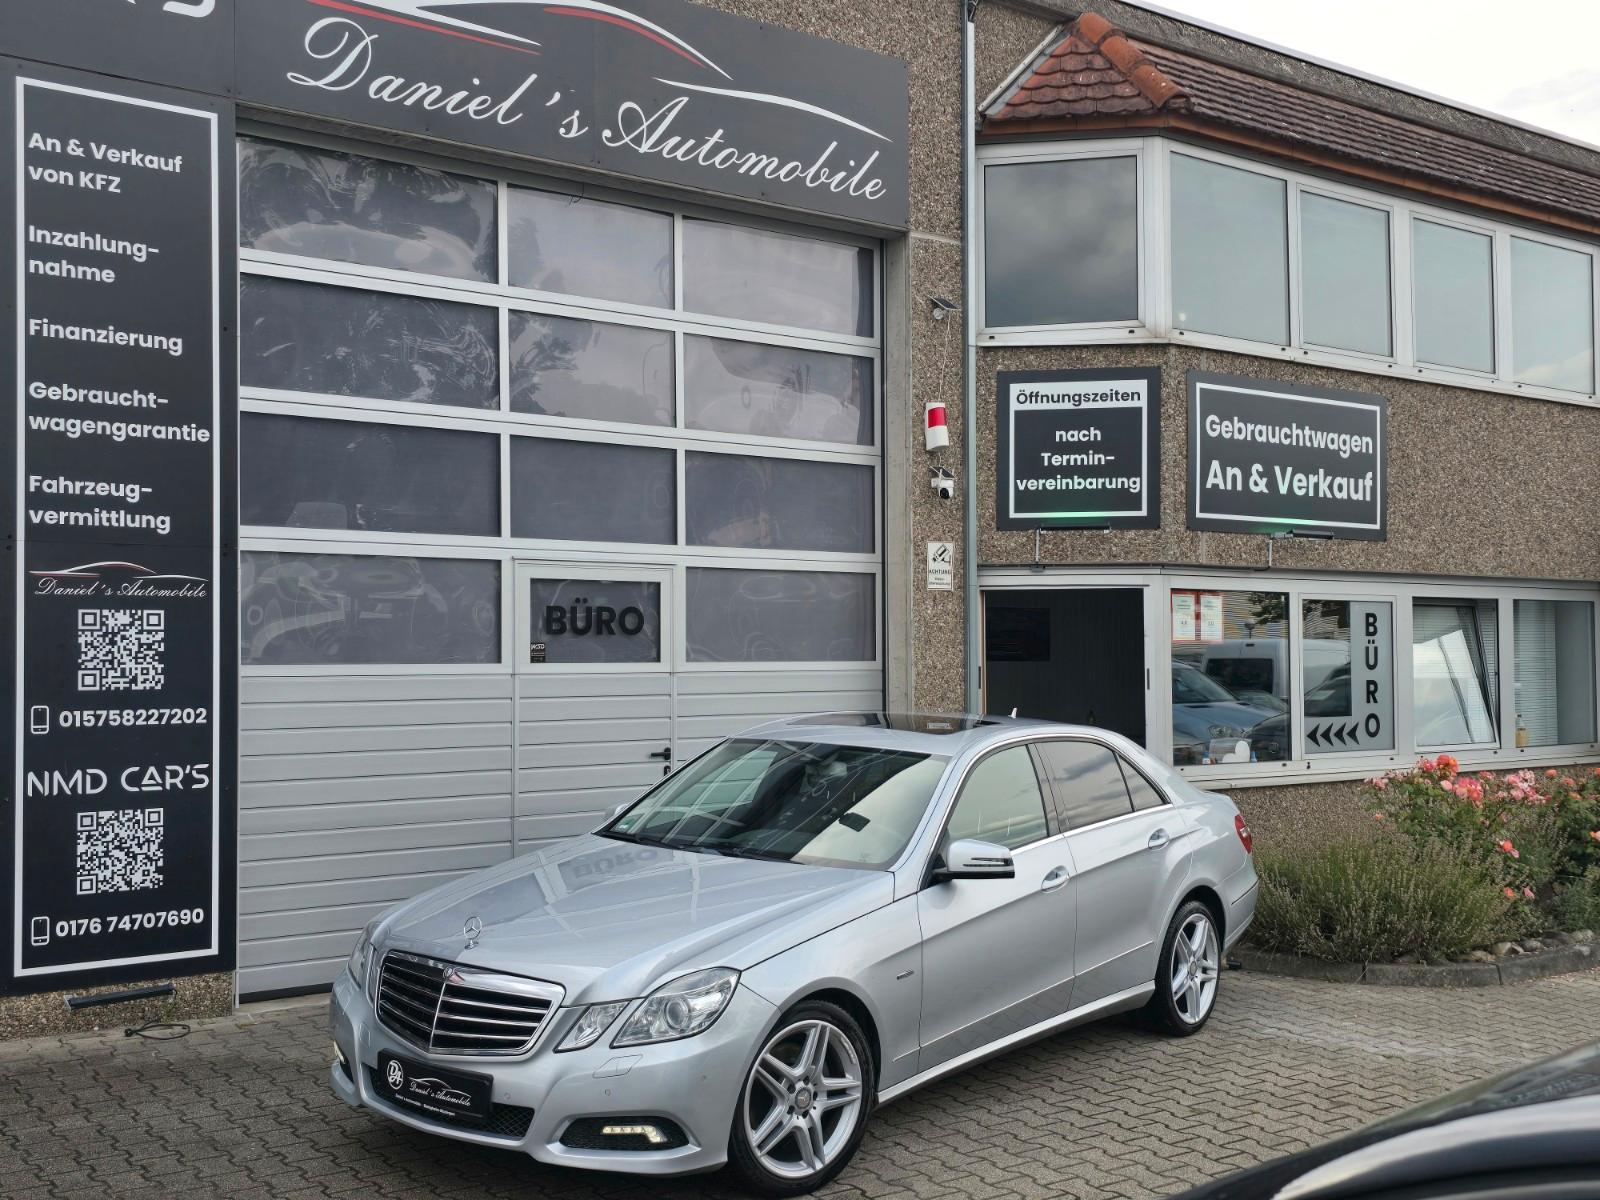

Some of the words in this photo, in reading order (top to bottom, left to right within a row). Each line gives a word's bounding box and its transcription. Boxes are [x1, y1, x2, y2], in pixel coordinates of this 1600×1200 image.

[287, 17, 588, 138] Daniel's
[602, 96, 887, 199] Automobile
[28, 132, 61, 153] An
[66, 138, 85, 157] &
[90, 142, 183, 173] Verkauf
[28, 165, 73, 186] von
[80, 171, 121, 193] KFZ
[29, 225, 160, 262] Inzahlung-
[29, 258, 115, 283] nahme
[29, 318, 183, 356] Finanzierung
[29, 381, 169, 408] Gebraucht-
[1016, 389, 1141, 407] Öffnungszeiten
[29, 415, 210, 442] wagengarantie
[1055, 427, 1102, 442] nach
[1205, 414, 1373, 459] Gebrauchtwagen
[1041, 450, 1115, 466] Termin-
[29, 475, 152, 503] Fahrzeug-
[1016, 474, 1141, 493] vereinbarung
[1205, 459, 1243, 491] An
[1248, 463, 1269, 494] &
[1274, 465, 1373, 501] Verkauf
[29, 507, 171, 534] vermittlung
[34, 577, 113, 596] Daniel's
[116, 579, 208, 598] Automobile
[545, 597, 645, 636] BÜRO
[1365, 612, 1381, 738] BÜRO
[58, 707, 208, 727] 015758227202
[27, 768, 108, 797] NMD
[120, 763, 210, 792] CAR'S
[55, 918, 102, 937] 0176
[106, 908, 204, 932] 74707690
